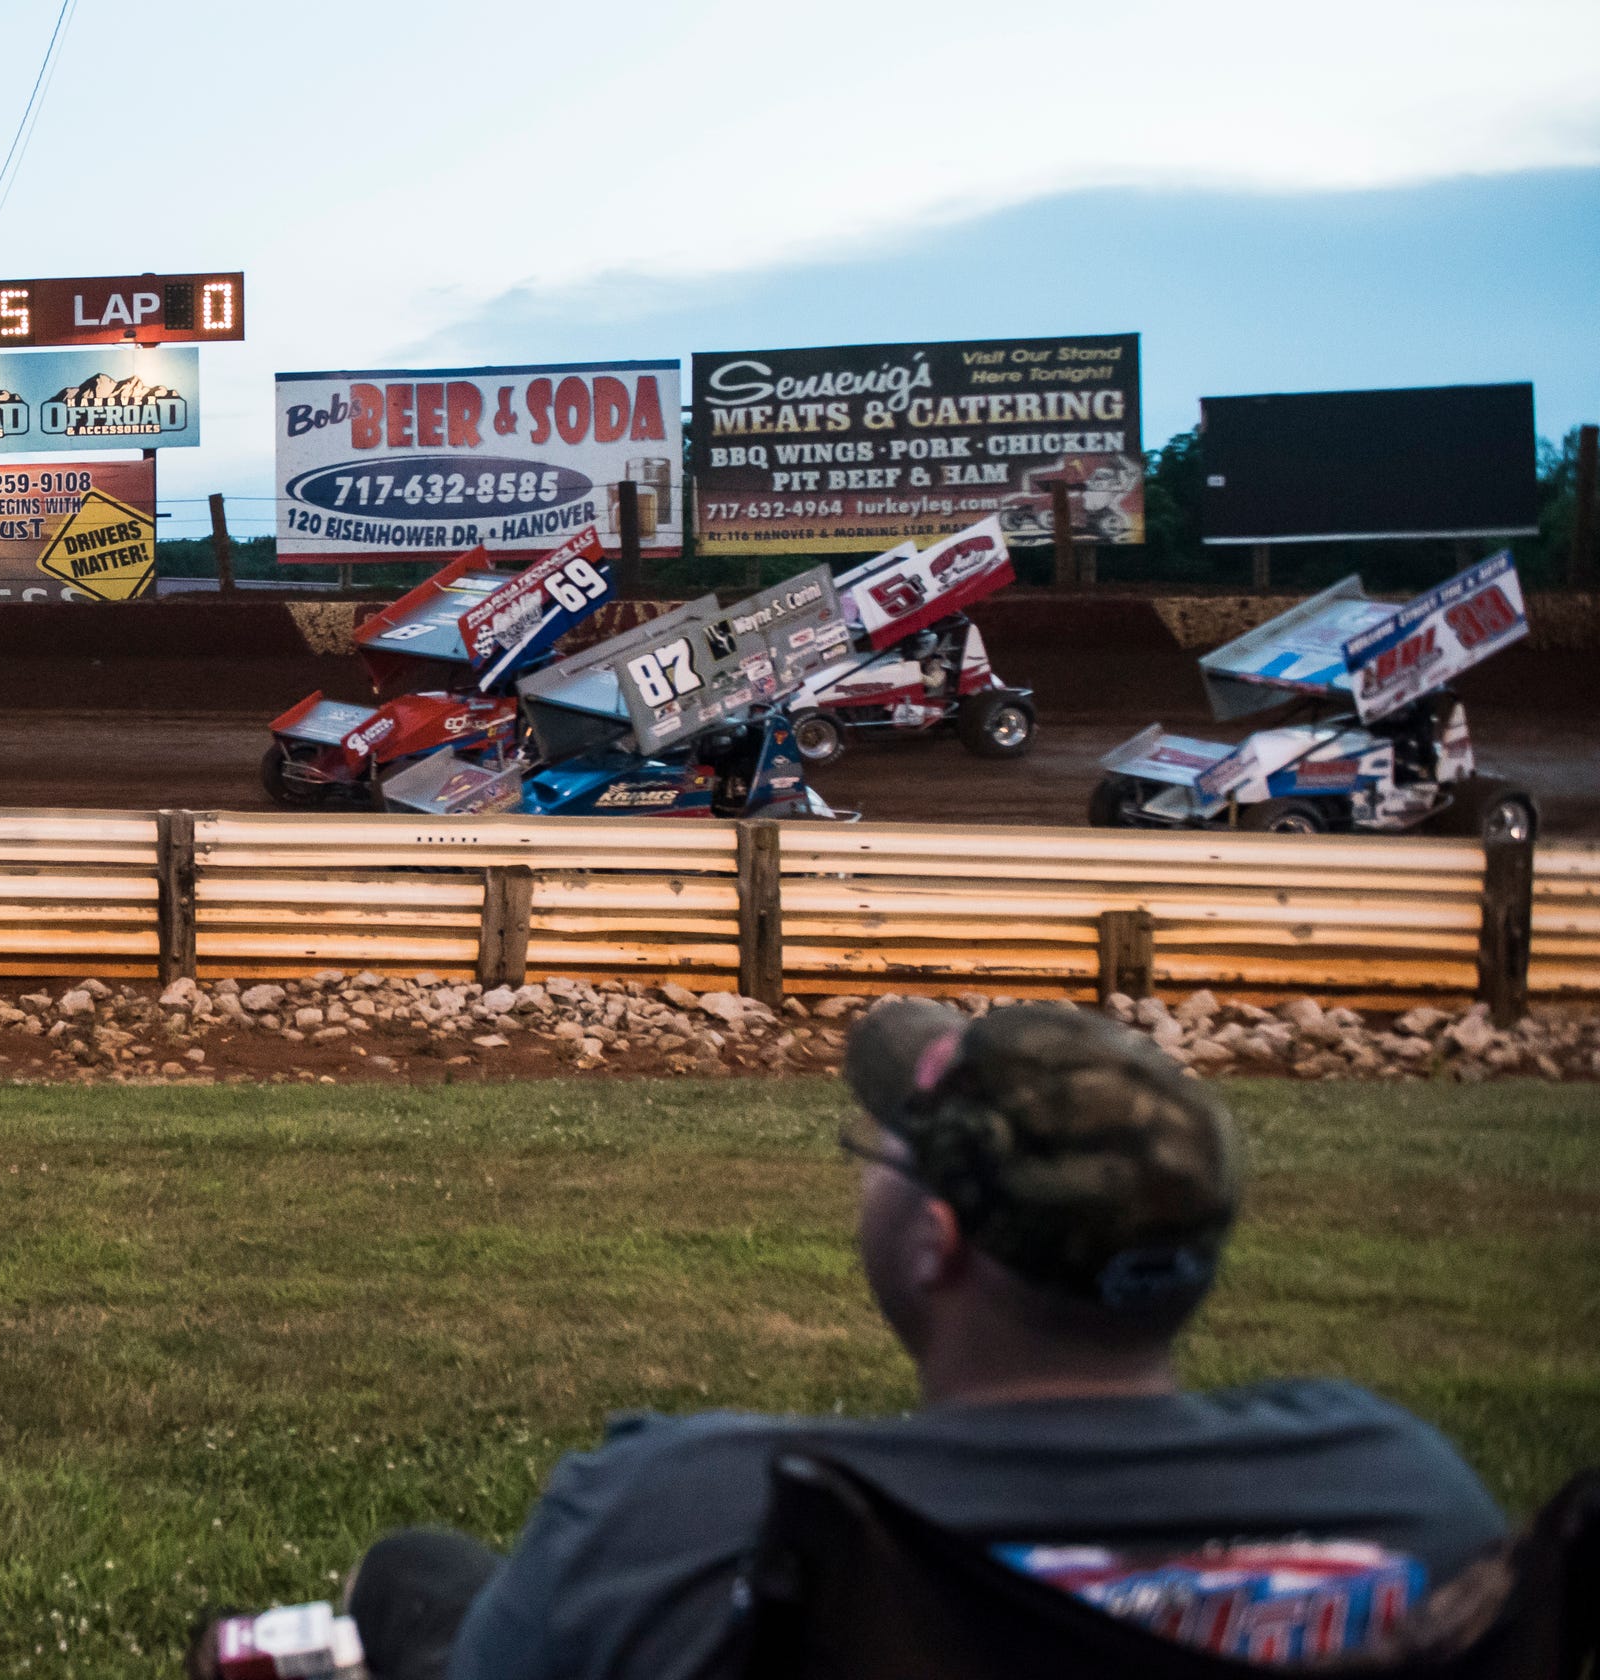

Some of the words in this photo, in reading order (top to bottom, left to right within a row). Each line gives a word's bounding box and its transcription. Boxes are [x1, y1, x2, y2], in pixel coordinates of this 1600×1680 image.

[74, 292, 160, 326] LAP
[203, 283, 232, 330] 0
[962, 350, 1006, 365] Visit
[1010, 349, 1052, 362] Our
[1057, 346, 1122, 361] Stand
[970, 370, 1023, 383] Here
[67, 396, 156, 407] HANOVER
[350, 381, 483, 450] BEER
[494, 386, 518, 435] &
[526, 375, 666, 445] SODA
[711, 402, 851, 436] MEATS
[863, 401, 895, 430] &
[907, 390, 1125, 427] CATERING
[67, 427, 75, 435] &
[80, 425, 160, 434] ACCESSORIES
[711, 446, 768, 469] BBQ
[774, 441, 874, 465] WINGS
[889, 437, 971, 460] PORK
[986, 432, 1125, 455] CHICKEN
[334, 471, 560, 507] 717-632-8585
[772, 471, 820, 492] PIT
[828, 468, 902, 490] BEEF
[910, 466, 931, 487] &
[941, 463, 1009, 485] HAM
[45, 498, 83, 515] WITH
[287, 508, 322, 534] 120
[324, 516, 446, 548] EISENHOWER
[502, 501, 596, 542] HANOVER
[707, 499, 842, 520] 717-632-4964
[856, 495, 998, 519] turkeyleg.com
[64, 519, 143, 556] DRIVERS
[754, 529, 814, 540] HANOVER
[834, 526, 898, 538] MORNING
[71, 542, 149, 578] MATTER!
[544, 557, 608, 613] 69
[627, 637, 704, 708] 87
